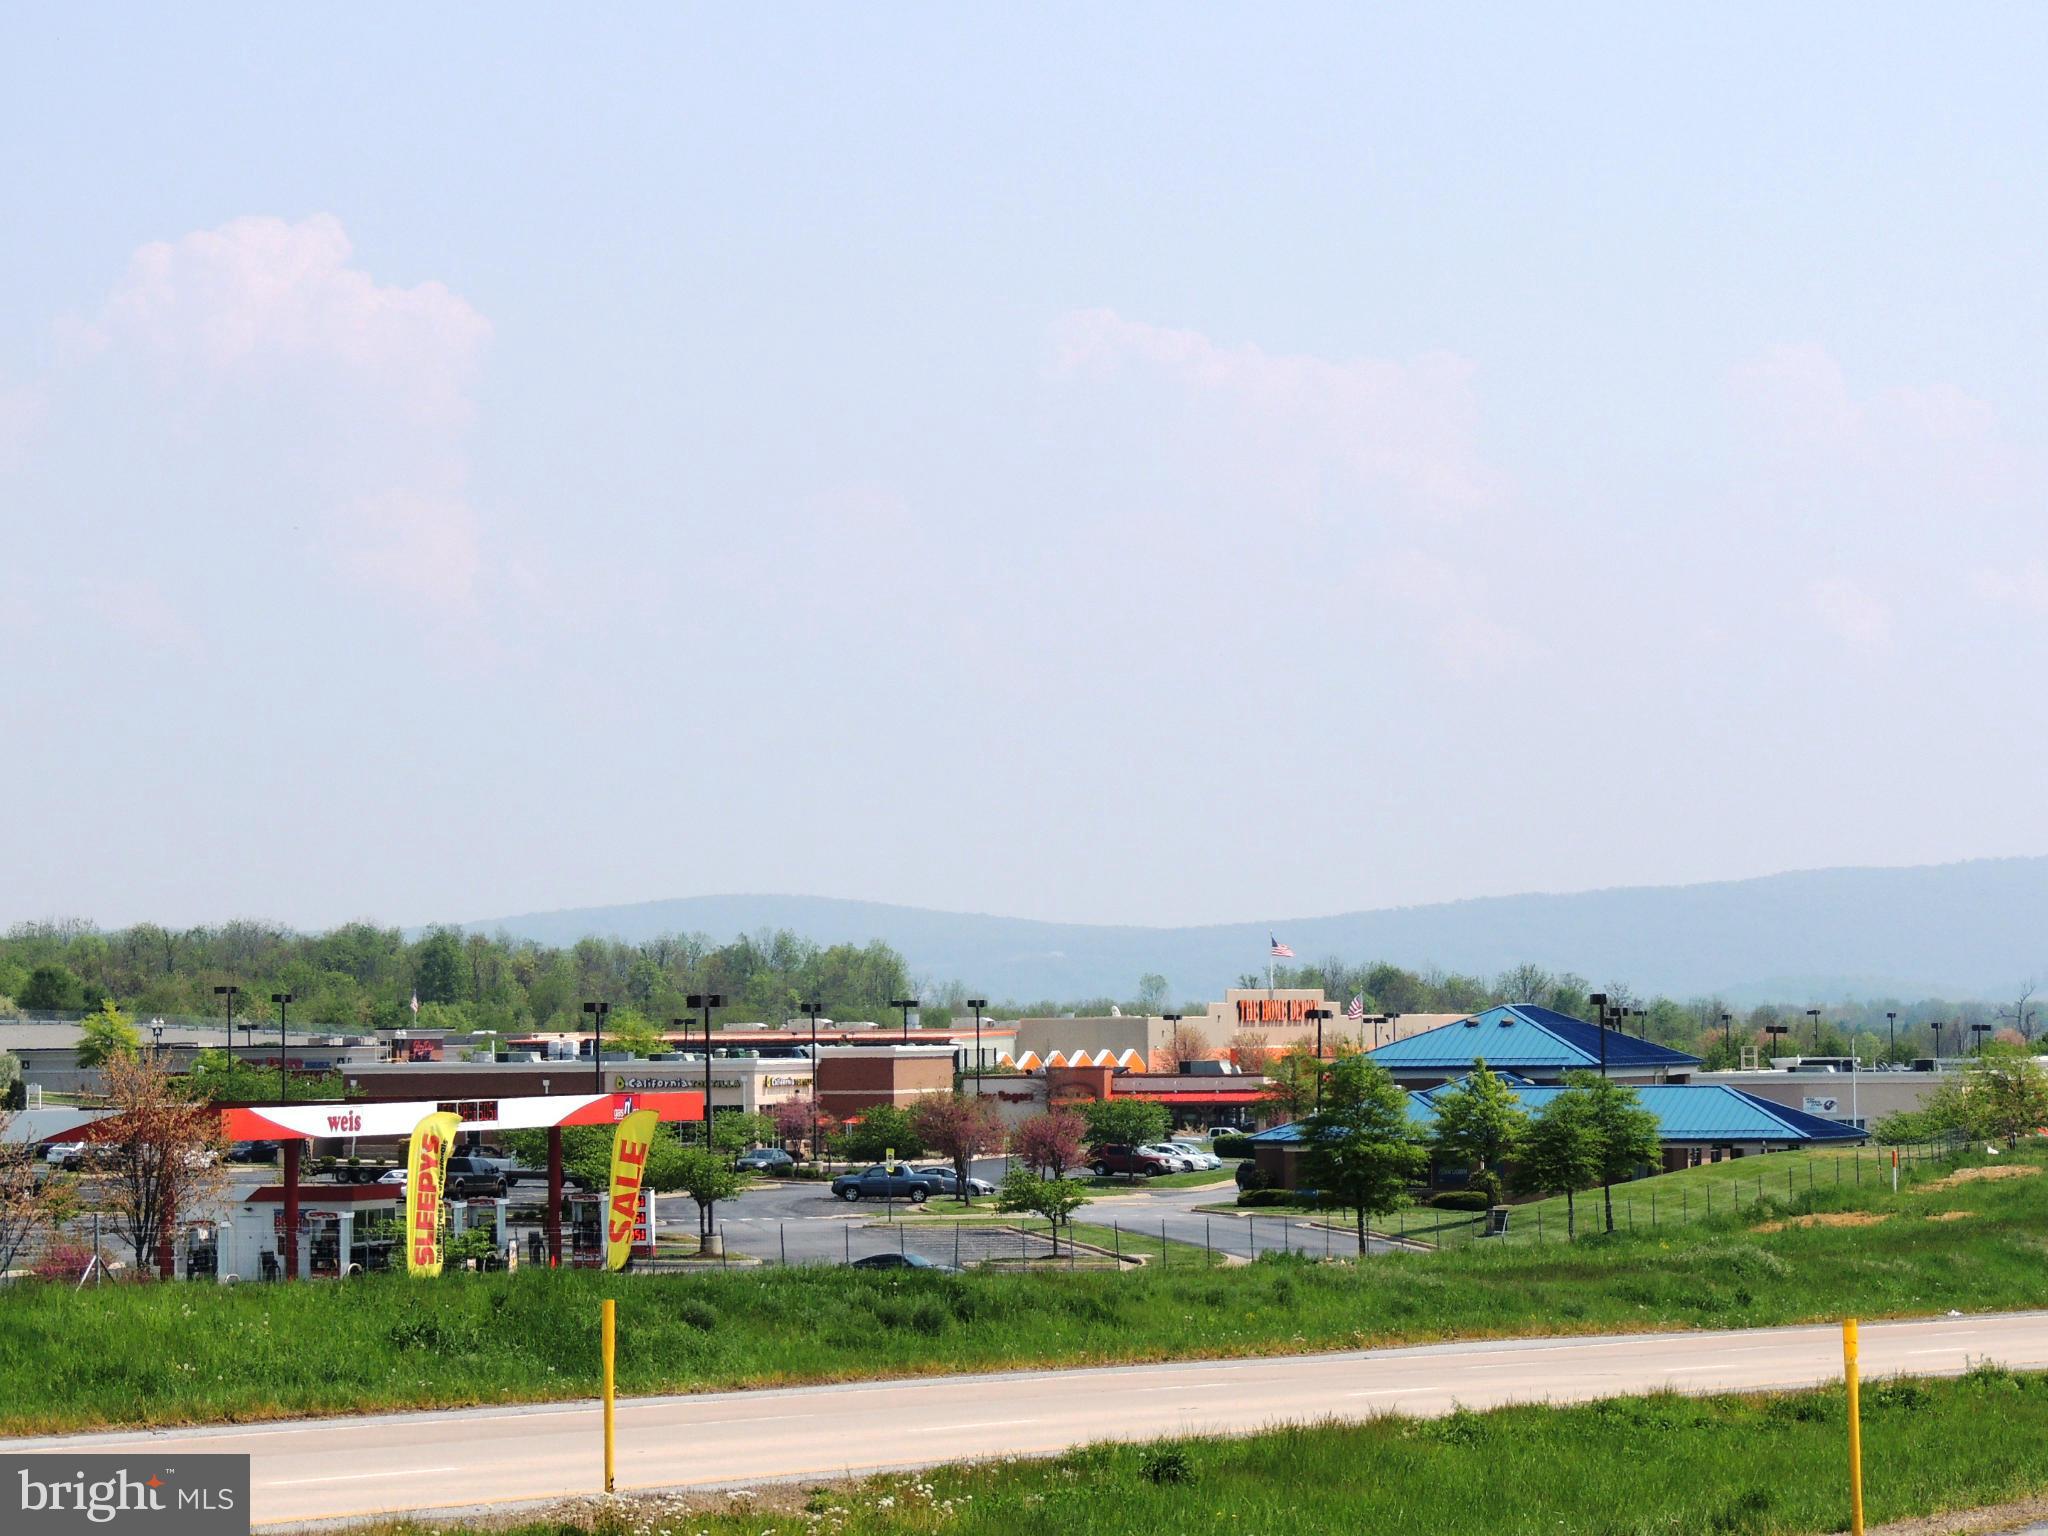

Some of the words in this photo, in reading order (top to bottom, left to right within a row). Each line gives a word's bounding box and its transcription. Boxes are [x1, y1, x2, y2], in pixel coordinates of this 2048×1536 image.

[1237, 1000, 1258, 1021] THE
[1260, 1000, 1286, 1021] HOME
[628, 1077, 688, 1088] California
[692, 1079, 741, 1088] TOTILLA
[327, 1110, 362, 1132] weis
[415, 1134, 440, 1266] SLEEPYS
[609, 1139, 648, 1244] SALE
[435, 1204, 444, 1246] Mattress
